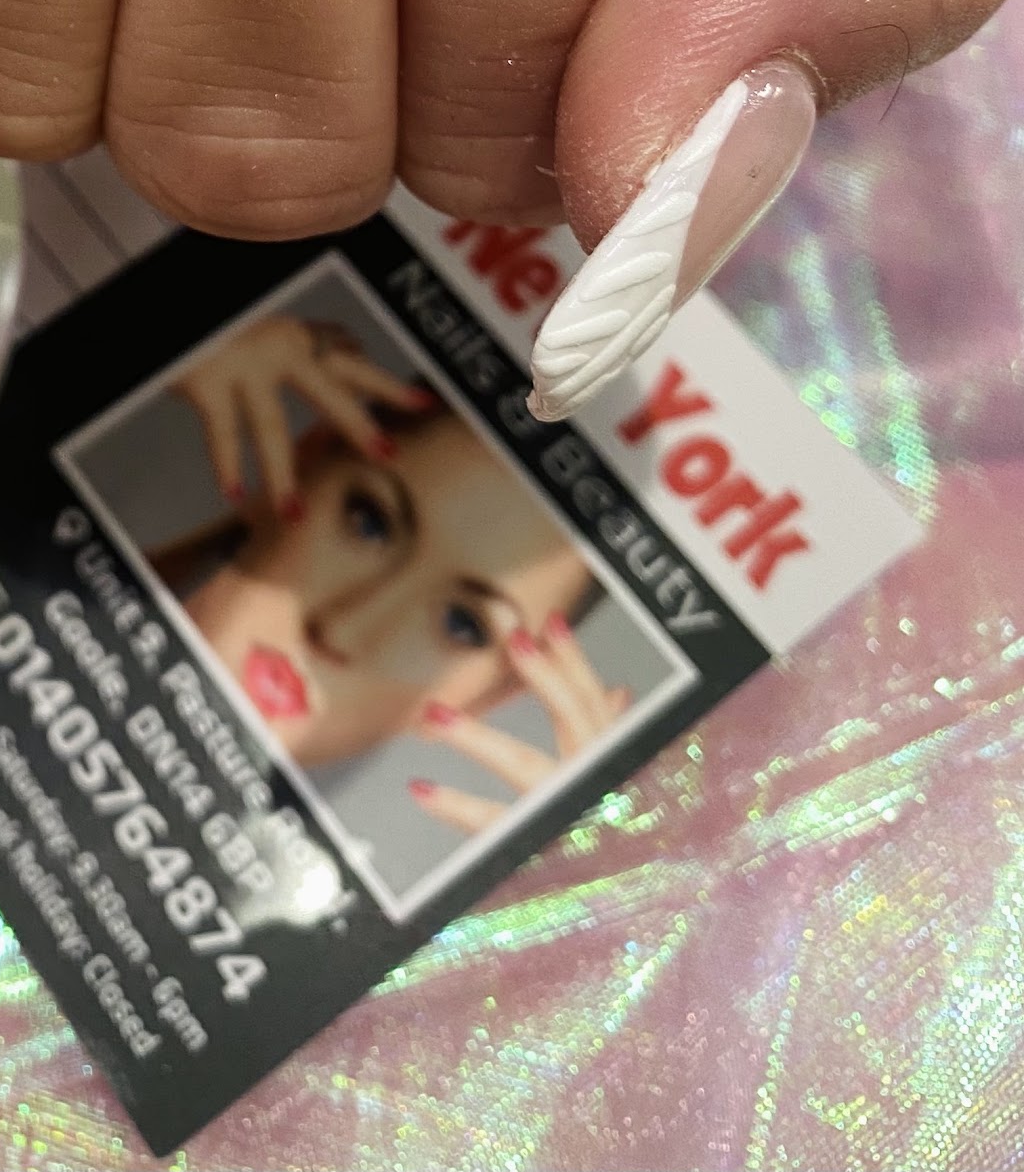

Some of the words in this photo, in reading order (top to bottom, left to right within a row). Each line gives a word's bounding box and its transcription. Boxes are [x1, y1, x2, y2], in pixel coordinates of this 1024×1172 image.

[386, 258, 505, 390] Nails
[538, 435, 722, 637] Beauty
[444, 220, 560, 340] Ne
[615, 359, 814, 593] York
[76, 548, 142, 633] Unit
[160, 662, 272, 810] Pasture
[125, 706, 214, 819] DN14
[82, 953, 163, 1057] Closed
[152, 976, 209, 1053] 6pm
